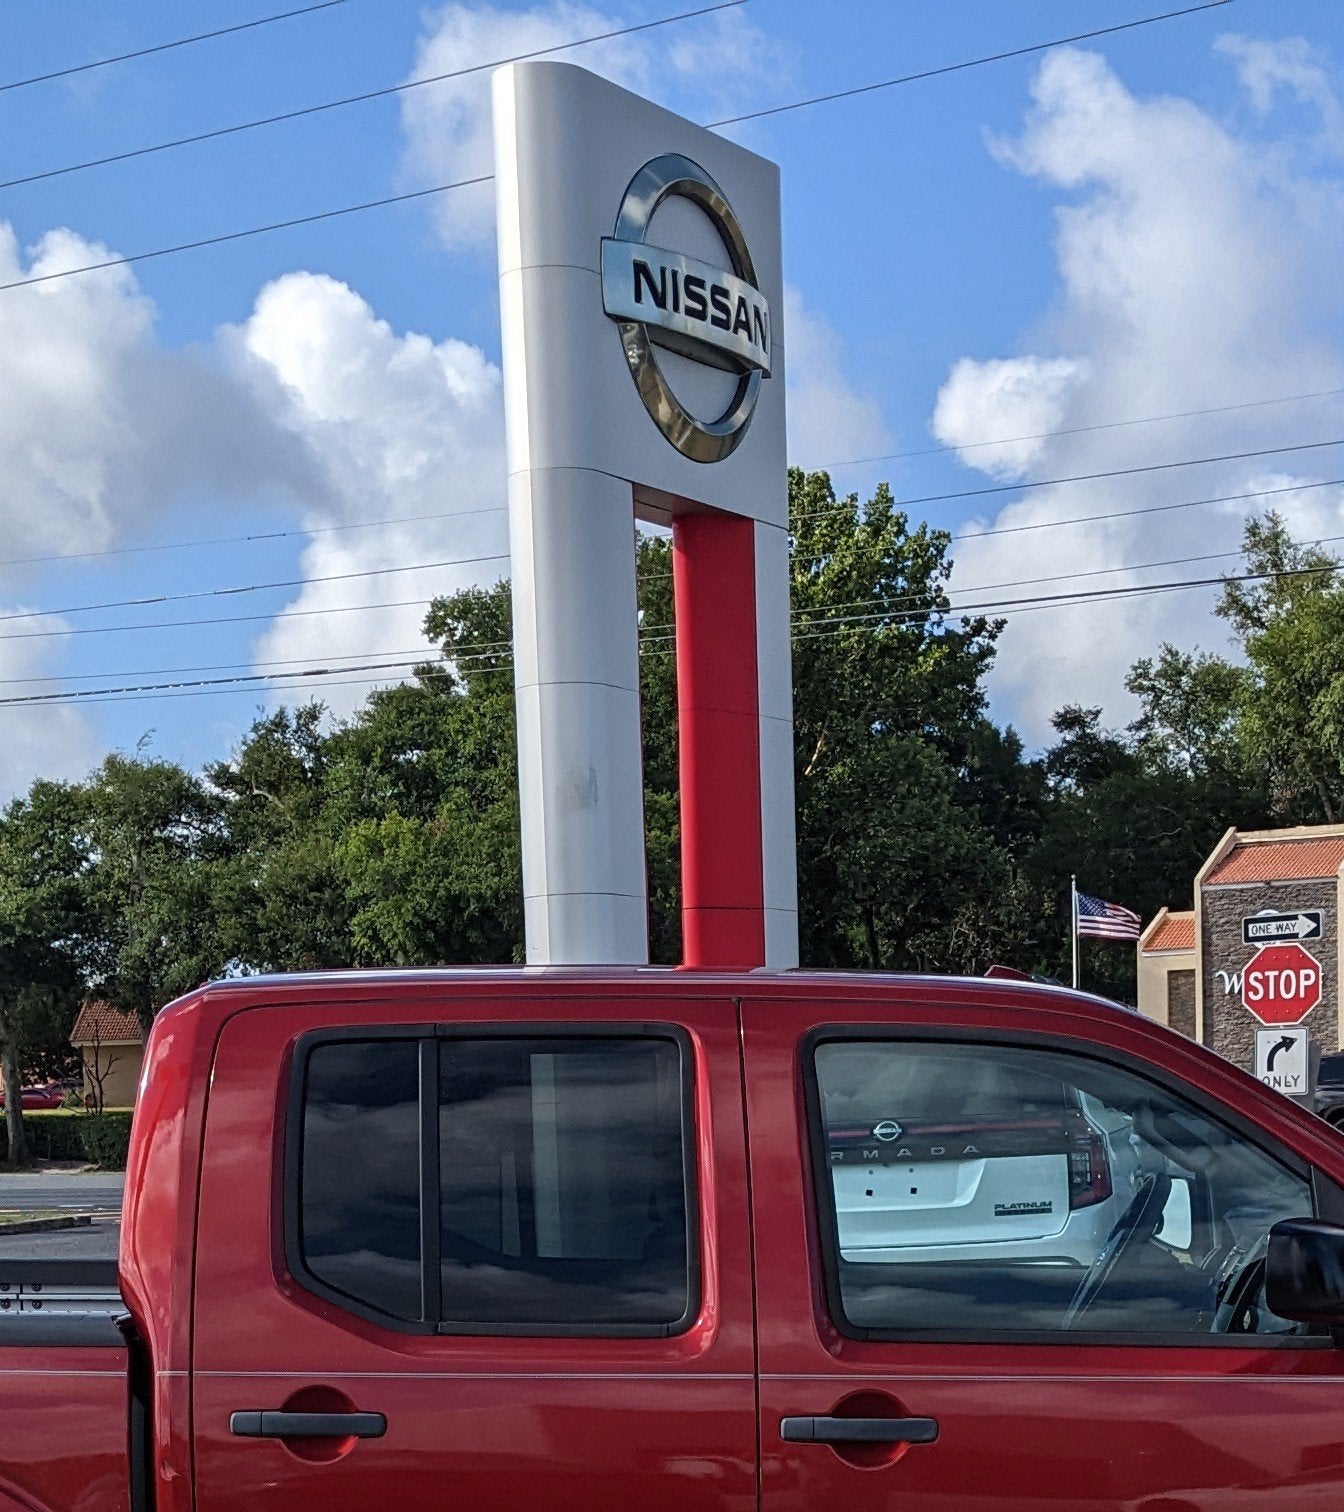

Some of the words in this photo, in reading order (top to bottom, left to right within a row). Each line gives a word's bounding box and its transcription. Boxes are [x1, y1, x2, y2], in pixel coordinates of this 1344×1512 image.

[632, 259, 770, 355] NISSAN
[1251, 924, 1272, 936] ONE
[1275, 922, 1297, 934] WAY
[1248, 969, 1316, 1001] STOP
[994, 1201, 1053, 1210] PLATINUM
